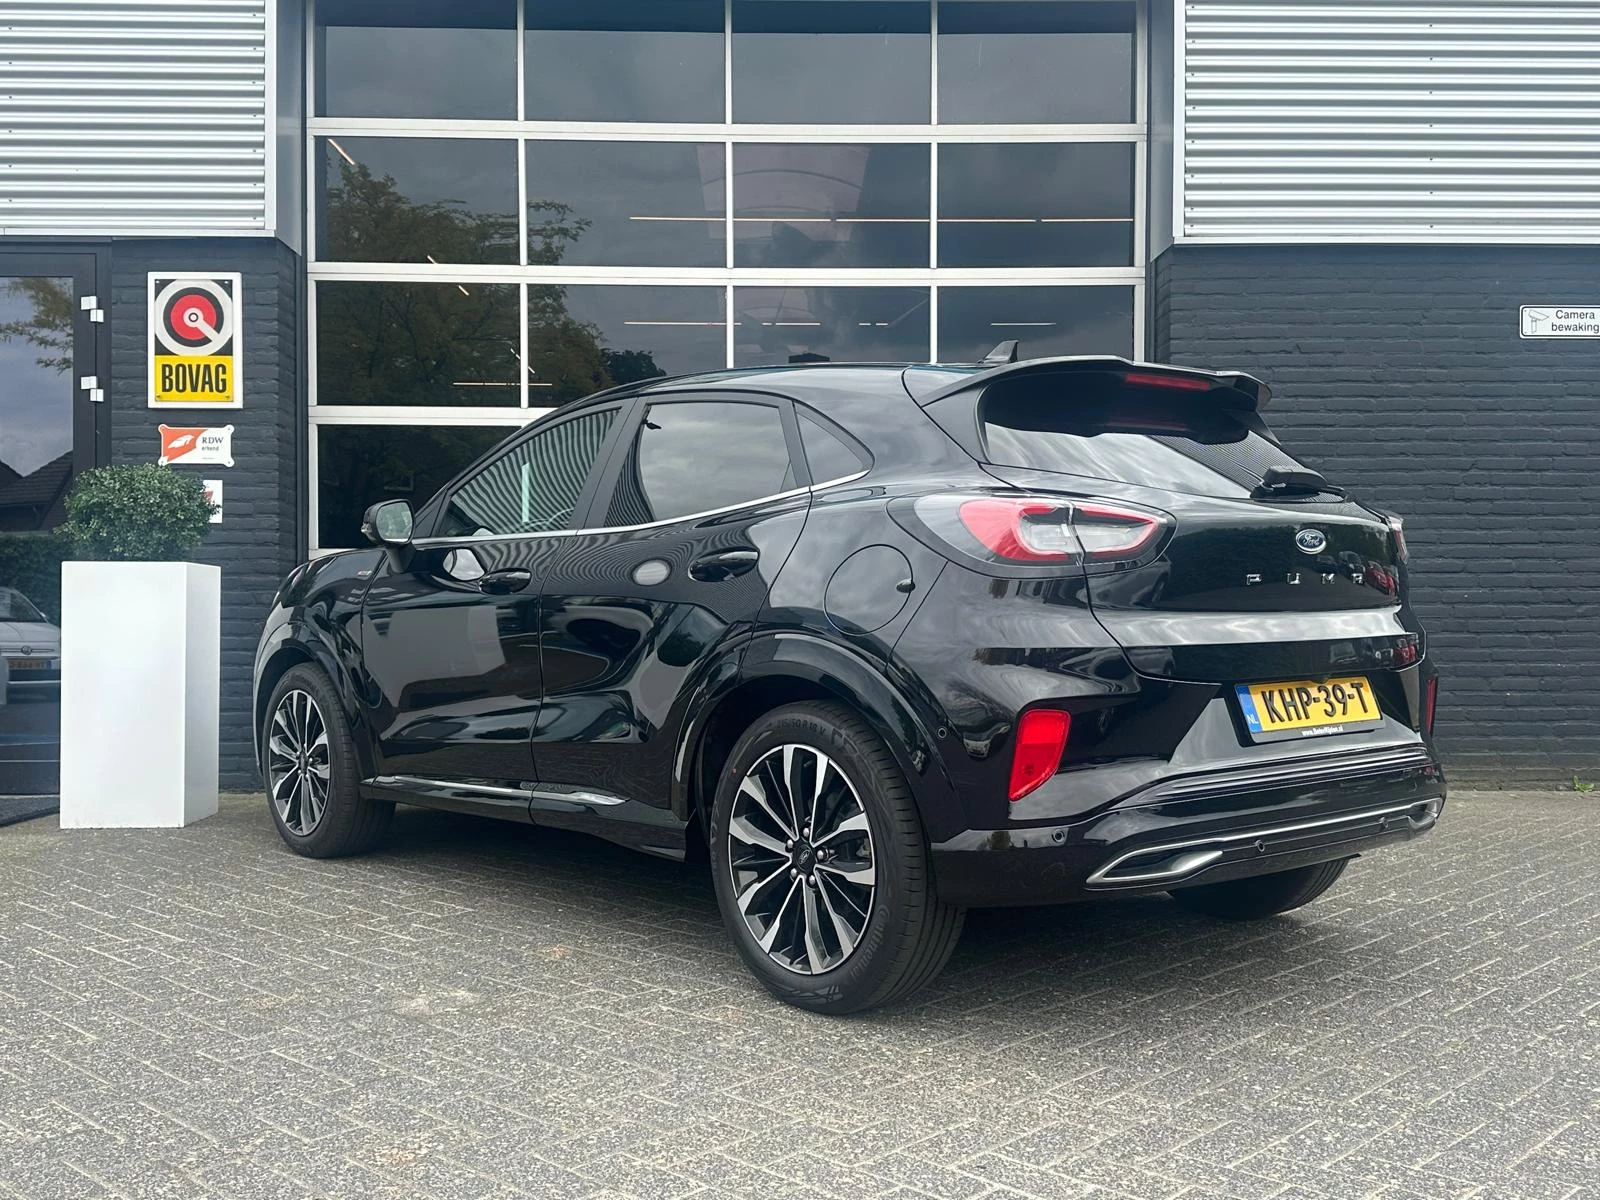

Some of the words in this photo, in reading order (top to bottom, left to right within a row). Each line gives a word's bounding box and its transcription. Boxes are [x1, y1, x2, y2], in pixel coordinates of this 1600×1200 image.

[1555, 309, 1596, 320] Camera
[1551, 322, 1600, 334] bewaking
[161, 363, 227, 393] BOVAG
[201, 436, 224, 444] RDW
[1246, 572, 1365, 585] PUMA
[1260, 682, 1368, 724] KHP-39-T
[1247, 713, 1259, 724] NL
